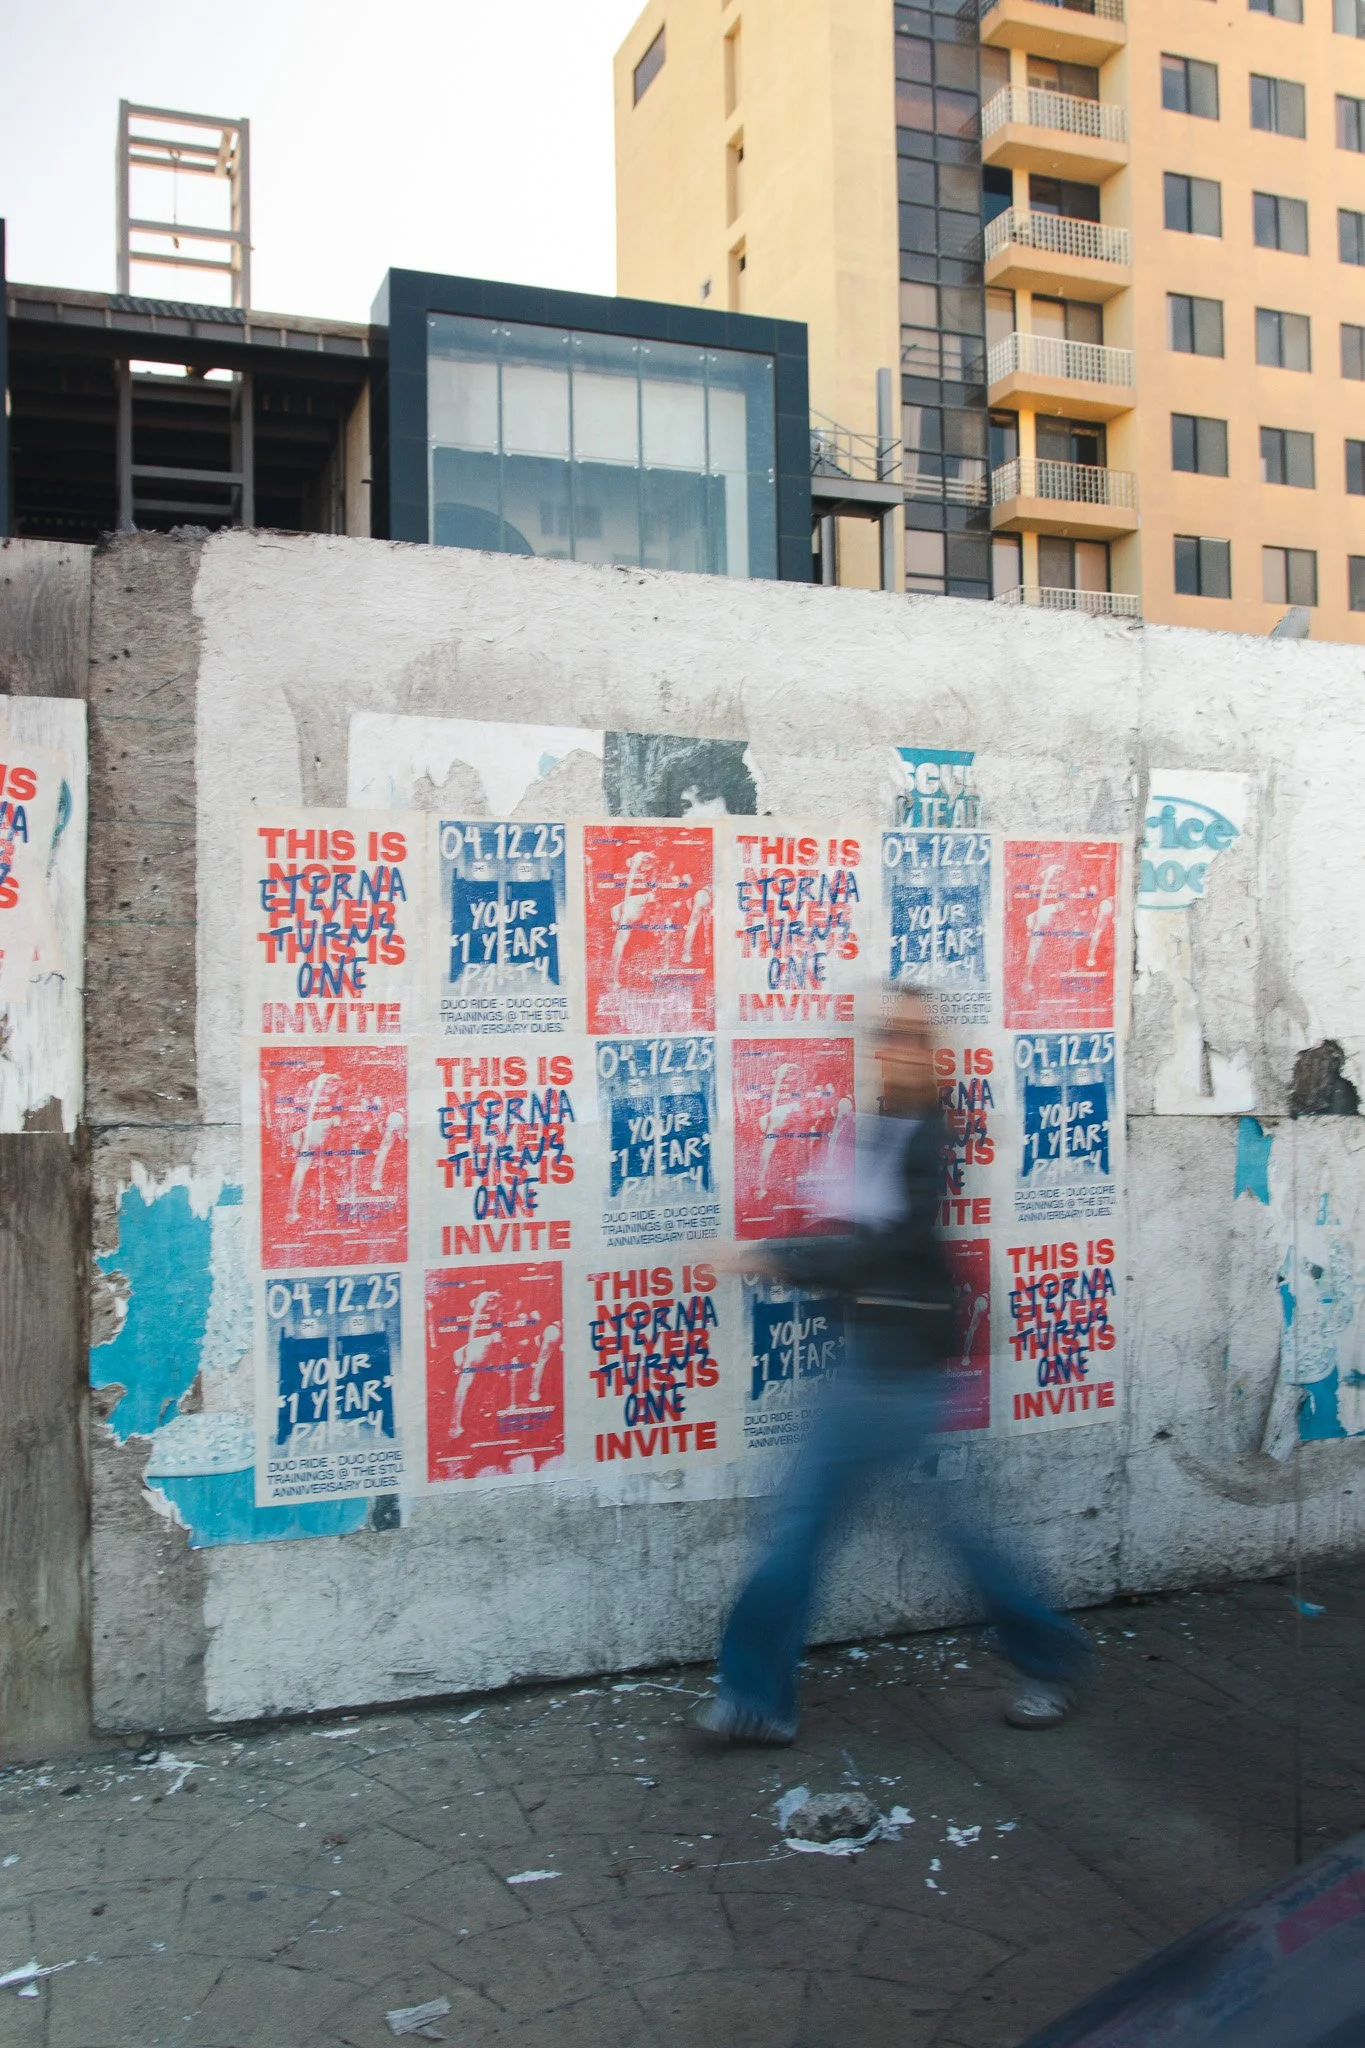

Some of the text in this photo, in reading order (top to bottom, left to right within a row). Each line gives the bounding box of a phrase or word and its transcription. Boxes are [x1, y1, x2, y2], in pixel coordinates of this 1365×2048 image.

[258, 828, 408, 862] THIS IS
[441, 824, 564, 860] 04.12.25
[736, 836, 861, 867] THIS IS
[884, 835, 991, 868] 04.12.25
[258, 865, 407, 913] ETERNA
[268, 863, 356, 894] NOT
[736, 870, 859, 913] ETERNA
[269, 898, 396, 929] FLYER
[470, 900, 538, 930] YOUR
[908, 903, 965, 931] YOUR
[257, 933, 406, 965] THIS IS
[827, 932, 858, 960] IS
[298, 955, 367, 998] ONE
[461, 956, 549, 996] PARTY
[768, 951, 827, 990] ONE
[262, 1002, 401, 1033] INVITE
[440, 1011, 503, 1022] TRAININGS
[520, 1010, 542, 1020] THE
[441, 998, 568, 1009] DUO RIDE DUO CORE
[738, 994, 855, 1021] INVITE
[445, 1023, 529, 1035] ANNIVERSARY
[599, 1038, 714, 1078] 04.12.25
[964, 1048, 993, 1075] IS
[1016, 1033, 1114, 1069] 04.12.25
[435, 1055, 573, 1087] THIS IS
[437, 1088, 575, 1139] ETERNA
[446, 1089, 527, 1120] NOT
[1039, 1101, 1094, 1129] YOUR
[447, 1122, 566, 1154] FLYER
[628, 1112, 692, 1144] YOUR
[965, 1137, 995, 1165] IS
[436, 1154, 575, 1188] THIS IS
[1031, 1150, 1102, 1187] PARTY
[474, 1176, 540, 1220] ONE
[621, 1165, 703, 1208] PARTY
[1015, 1191, 1037, 1200] DUO
[600, 1221, 660, 1235] TRAININGS
[676, 1218, 698, 1228] THE
[602, 1204, 721, 1223] DUO RIDE DUO CORE
[442, 1220, 571, 1255] INVITE
[607, 1232, 684, 1247] ANNIVERSARY
[1006, 1238, 1114, 1273] THIS IS
[268, 1274, 399, 1319] 04.12.25
[587, 1267, 673, 1301] THIS
[682, 1264, 717, 1293] IS
[1008, 1268, 1116, 1318] ETERNA
[1015, 1271, 1079, 1302] NOT
[589, 1296, 718, 1351] ETERNA
[597, 1299, 674, 1333] NOT
[1017, 1297, 1108, 1331] FLYER
[599, 1328, 710, 1365] FLYER
[769, 1317, 828, 1349] YOUR
[1009, 1324, 1116, 1361] THIS IS
[299, 1353, 372, 1389] YOUR
[589, 1358, 719, 1398] THIS IS
[1037, 1346, 1089, 1387] ONE
[624, 1382, 687, 1427] ONE
[1013, 1381, 1114, 1420] INVITE
[288, 1410, 383, 1456] PARTY
[743, 1422, 799, 1437] TRAININGS
[744, 1415, 768, 1426] DUO
[770, 1411, 793, 1422] RIDE
[595, 1421, 717, 1462] INVITE
[266, 1470, 335, 1485] TRAININGS
[352, 1466, 376, 1477] THE
[268, 1450, 403, 1473] DUO RIDE DUO CORE
[272, 1480, 362, 1498] ANNIVERSARY
